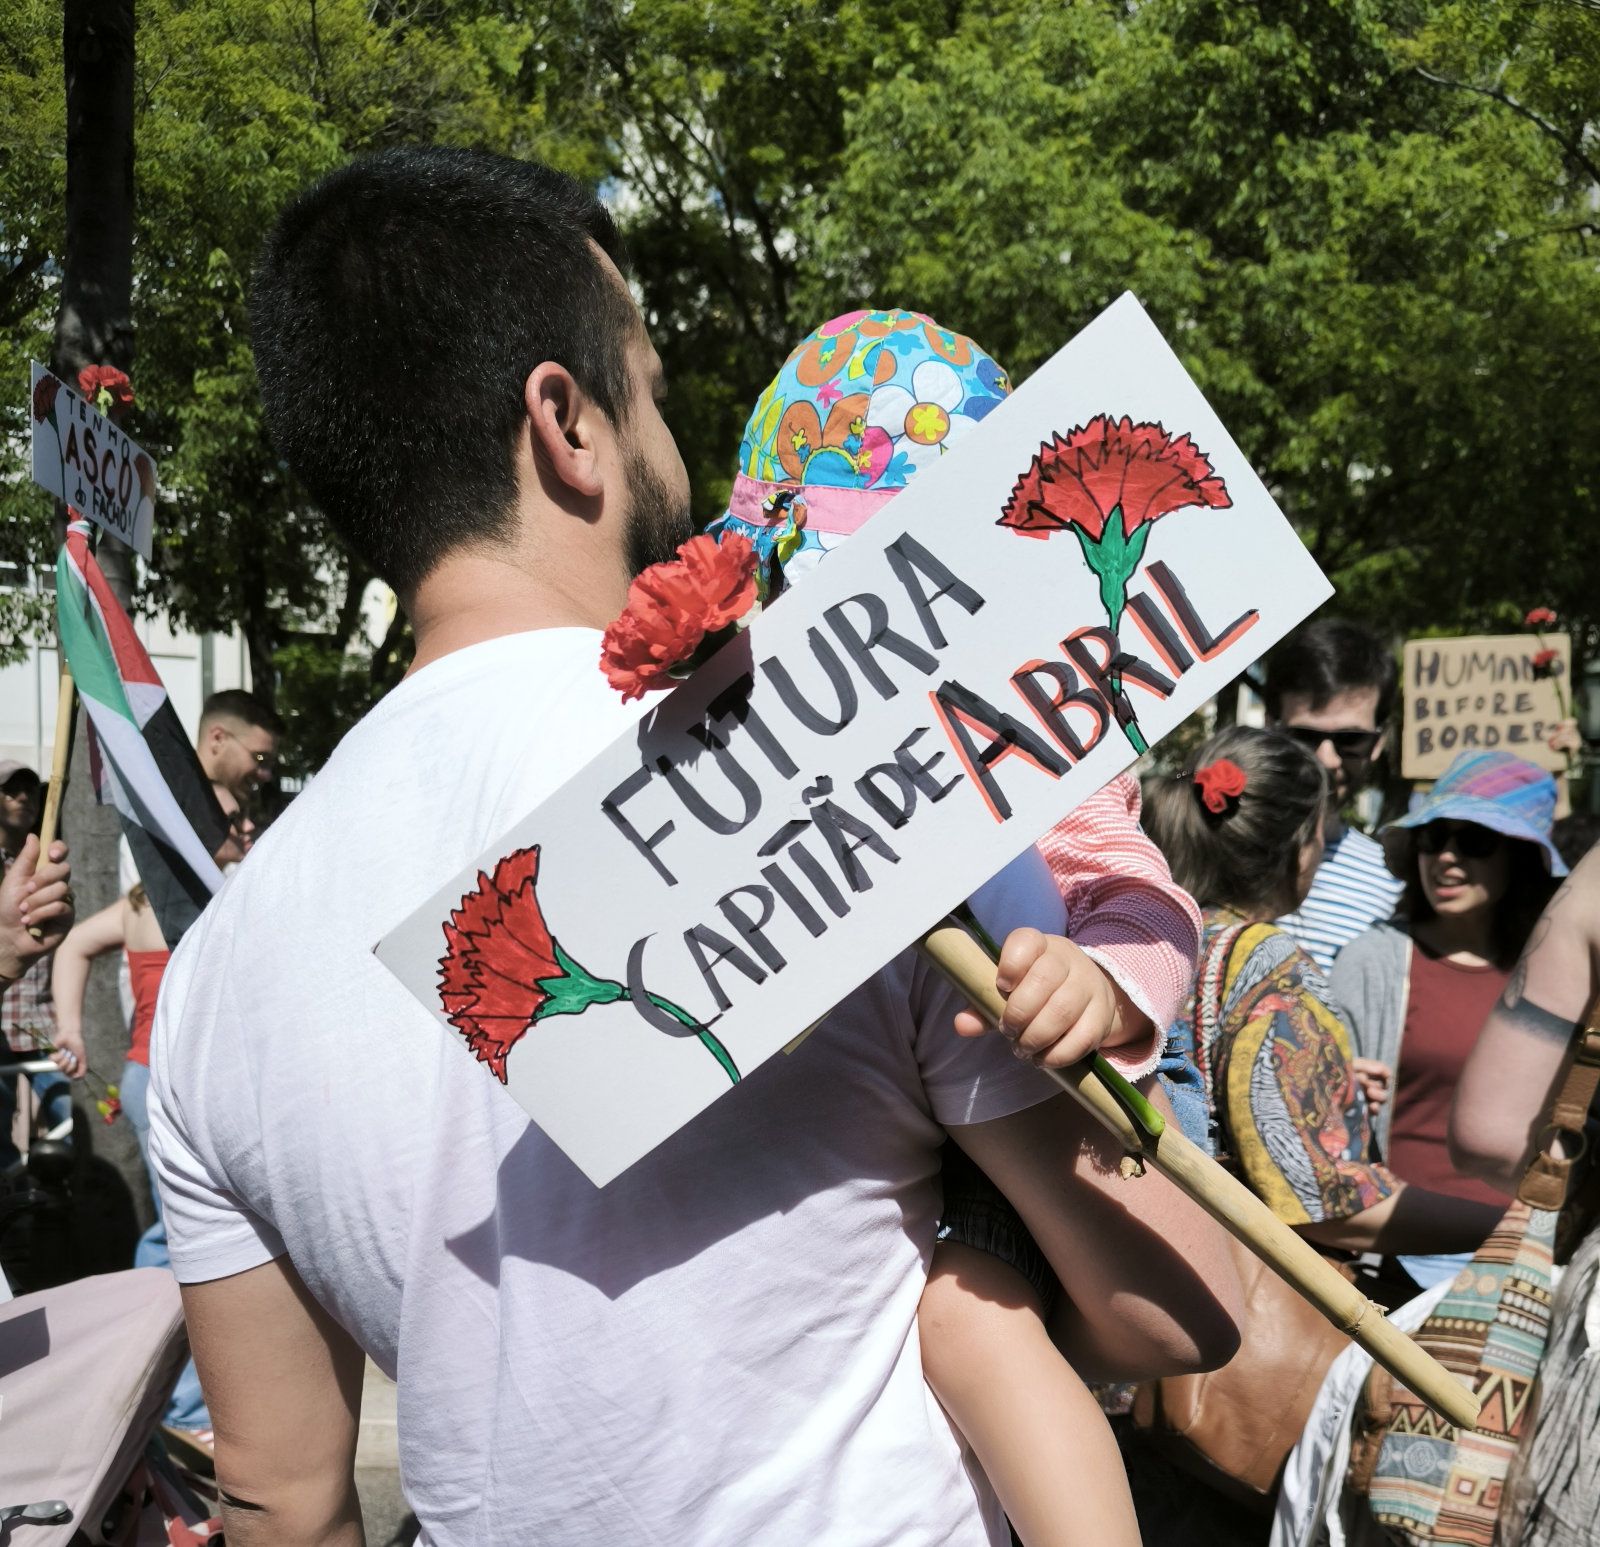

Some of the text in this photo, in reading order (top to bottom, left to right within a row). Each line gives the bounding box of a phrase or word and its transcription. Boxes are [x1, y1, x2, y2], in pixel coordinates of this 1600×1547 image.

[65, 422, 133, 507] ASCO
[601, 531, 986, 887] FUTURA
[626, 560, 1260, 1038] CAPITÃ DE ABRIL
[1415, 692, 1534, 720] BEFORE
